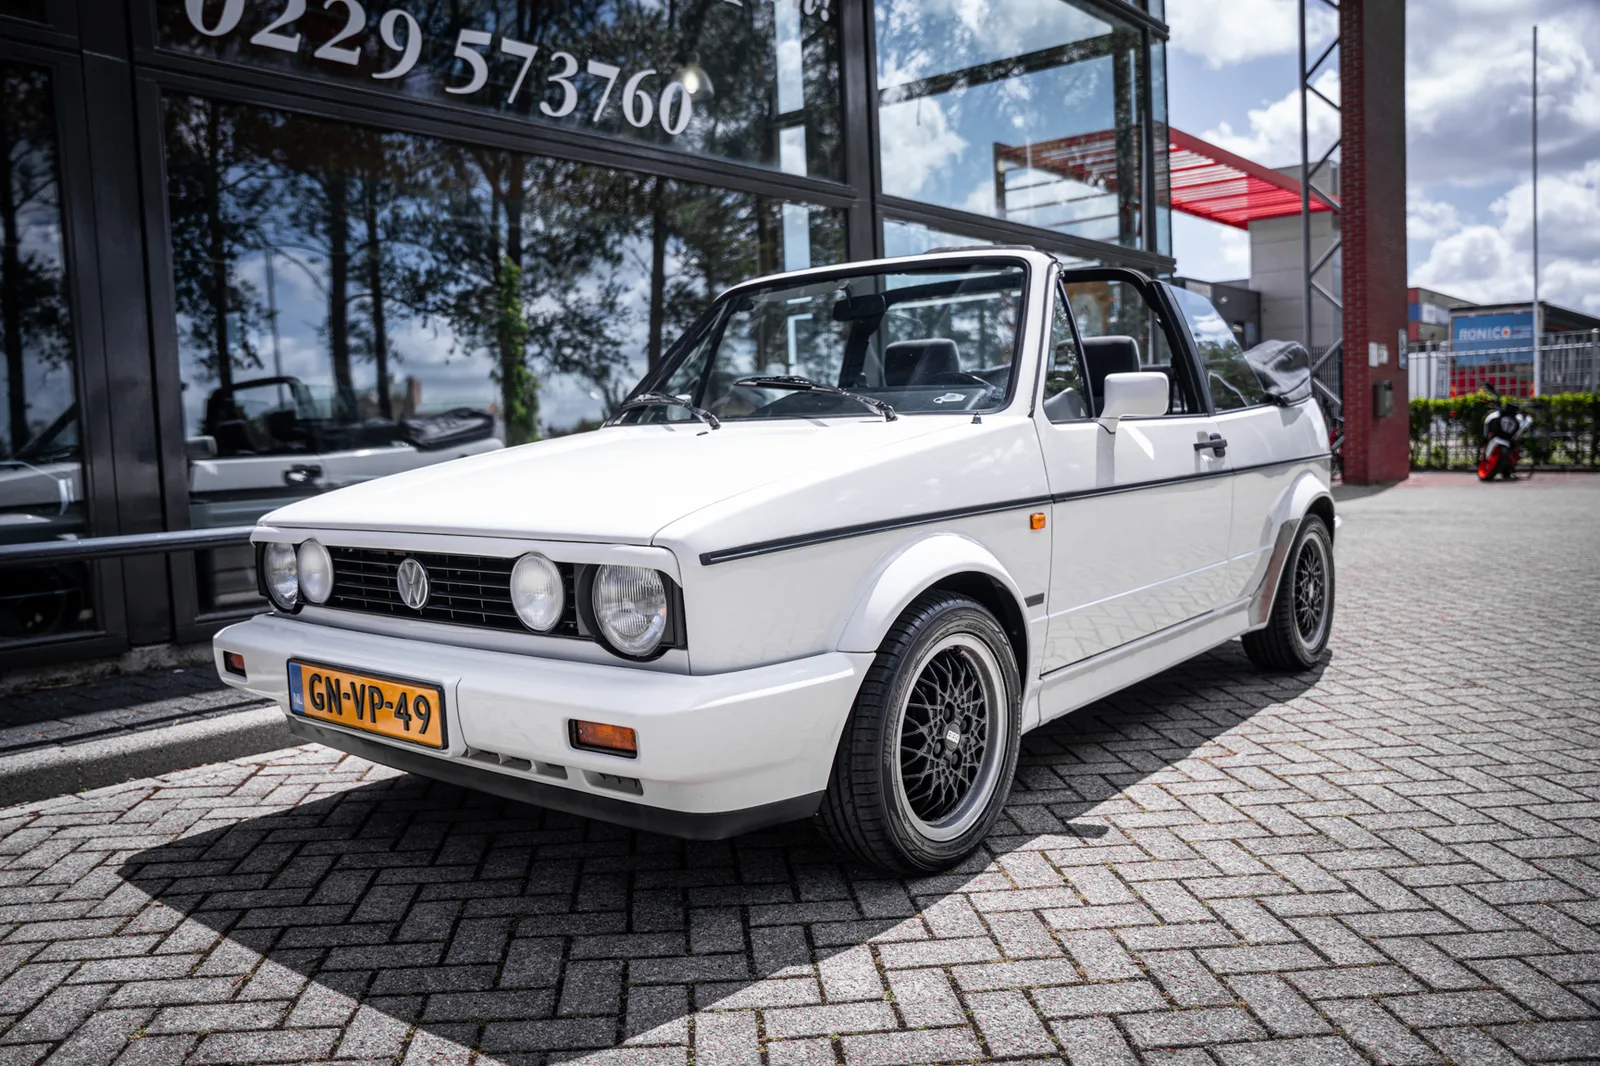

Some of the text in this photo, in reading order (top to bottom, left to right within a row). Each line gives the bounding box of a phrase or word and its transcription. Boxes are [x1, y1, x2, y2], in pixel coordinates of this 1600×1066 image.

[445, 28, 692, 135] 573760
[1459, 326, 1511, 340] RONICO
[292, 692, 303, 705] NL
[308, 673, 431, 735] GN-VP-49
